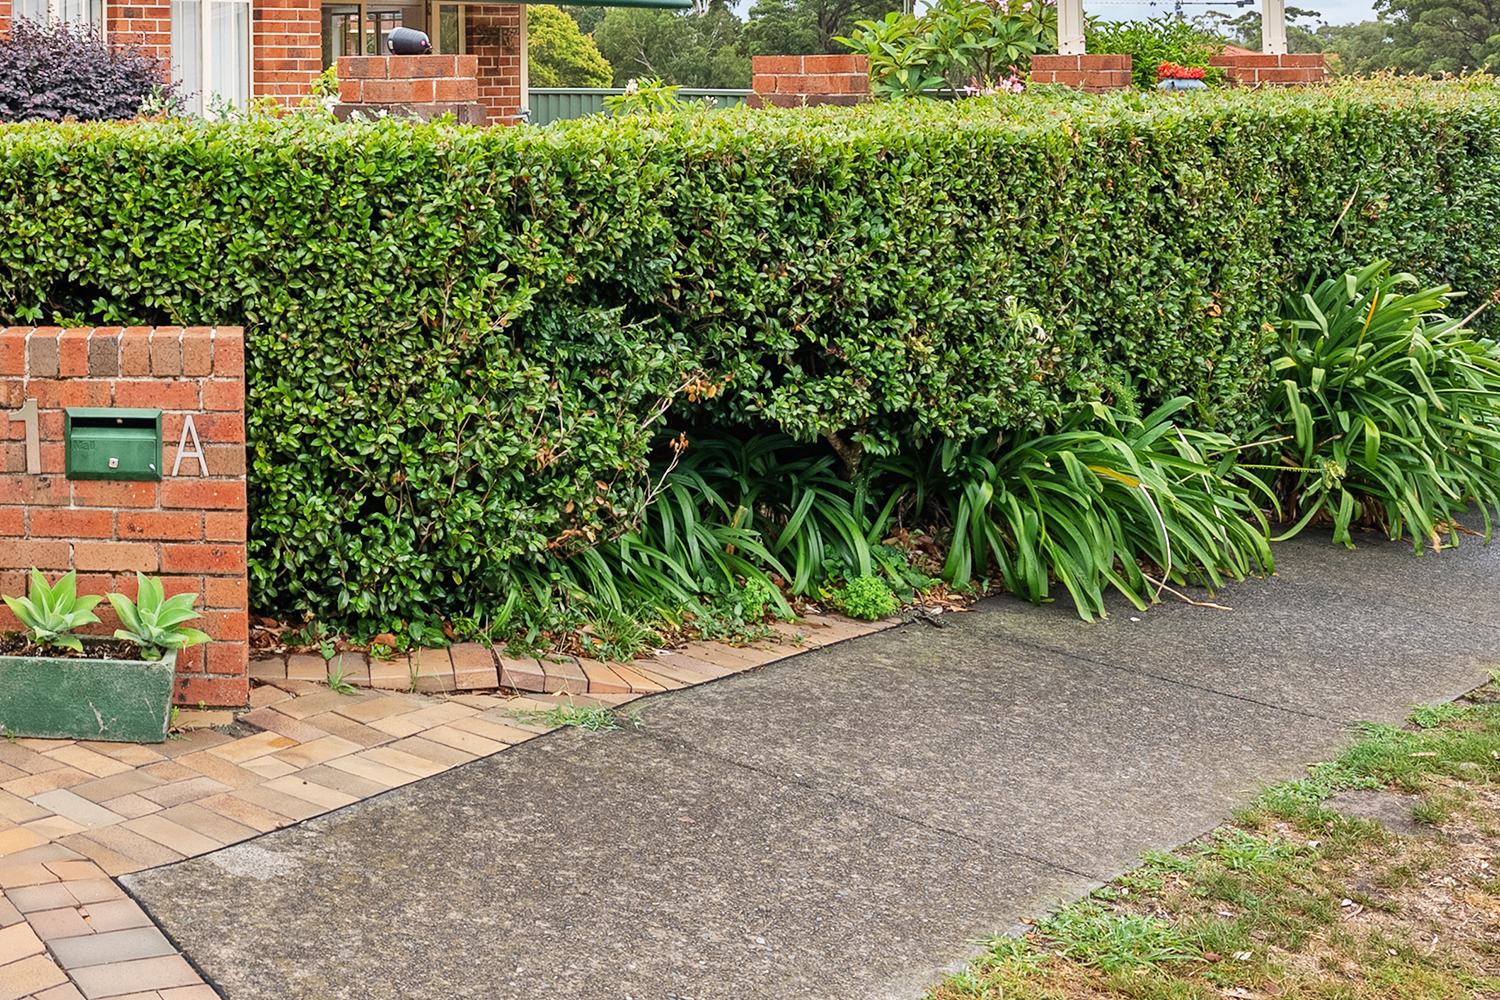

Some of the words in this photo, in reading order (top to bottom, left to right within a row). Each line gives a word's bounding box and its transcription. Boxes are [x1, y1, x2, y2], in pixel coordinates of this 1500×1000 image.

[8, 398, 41, 475] 1
[73, 440, 96, 451] Mail
[171, 415, 210, 477] A
